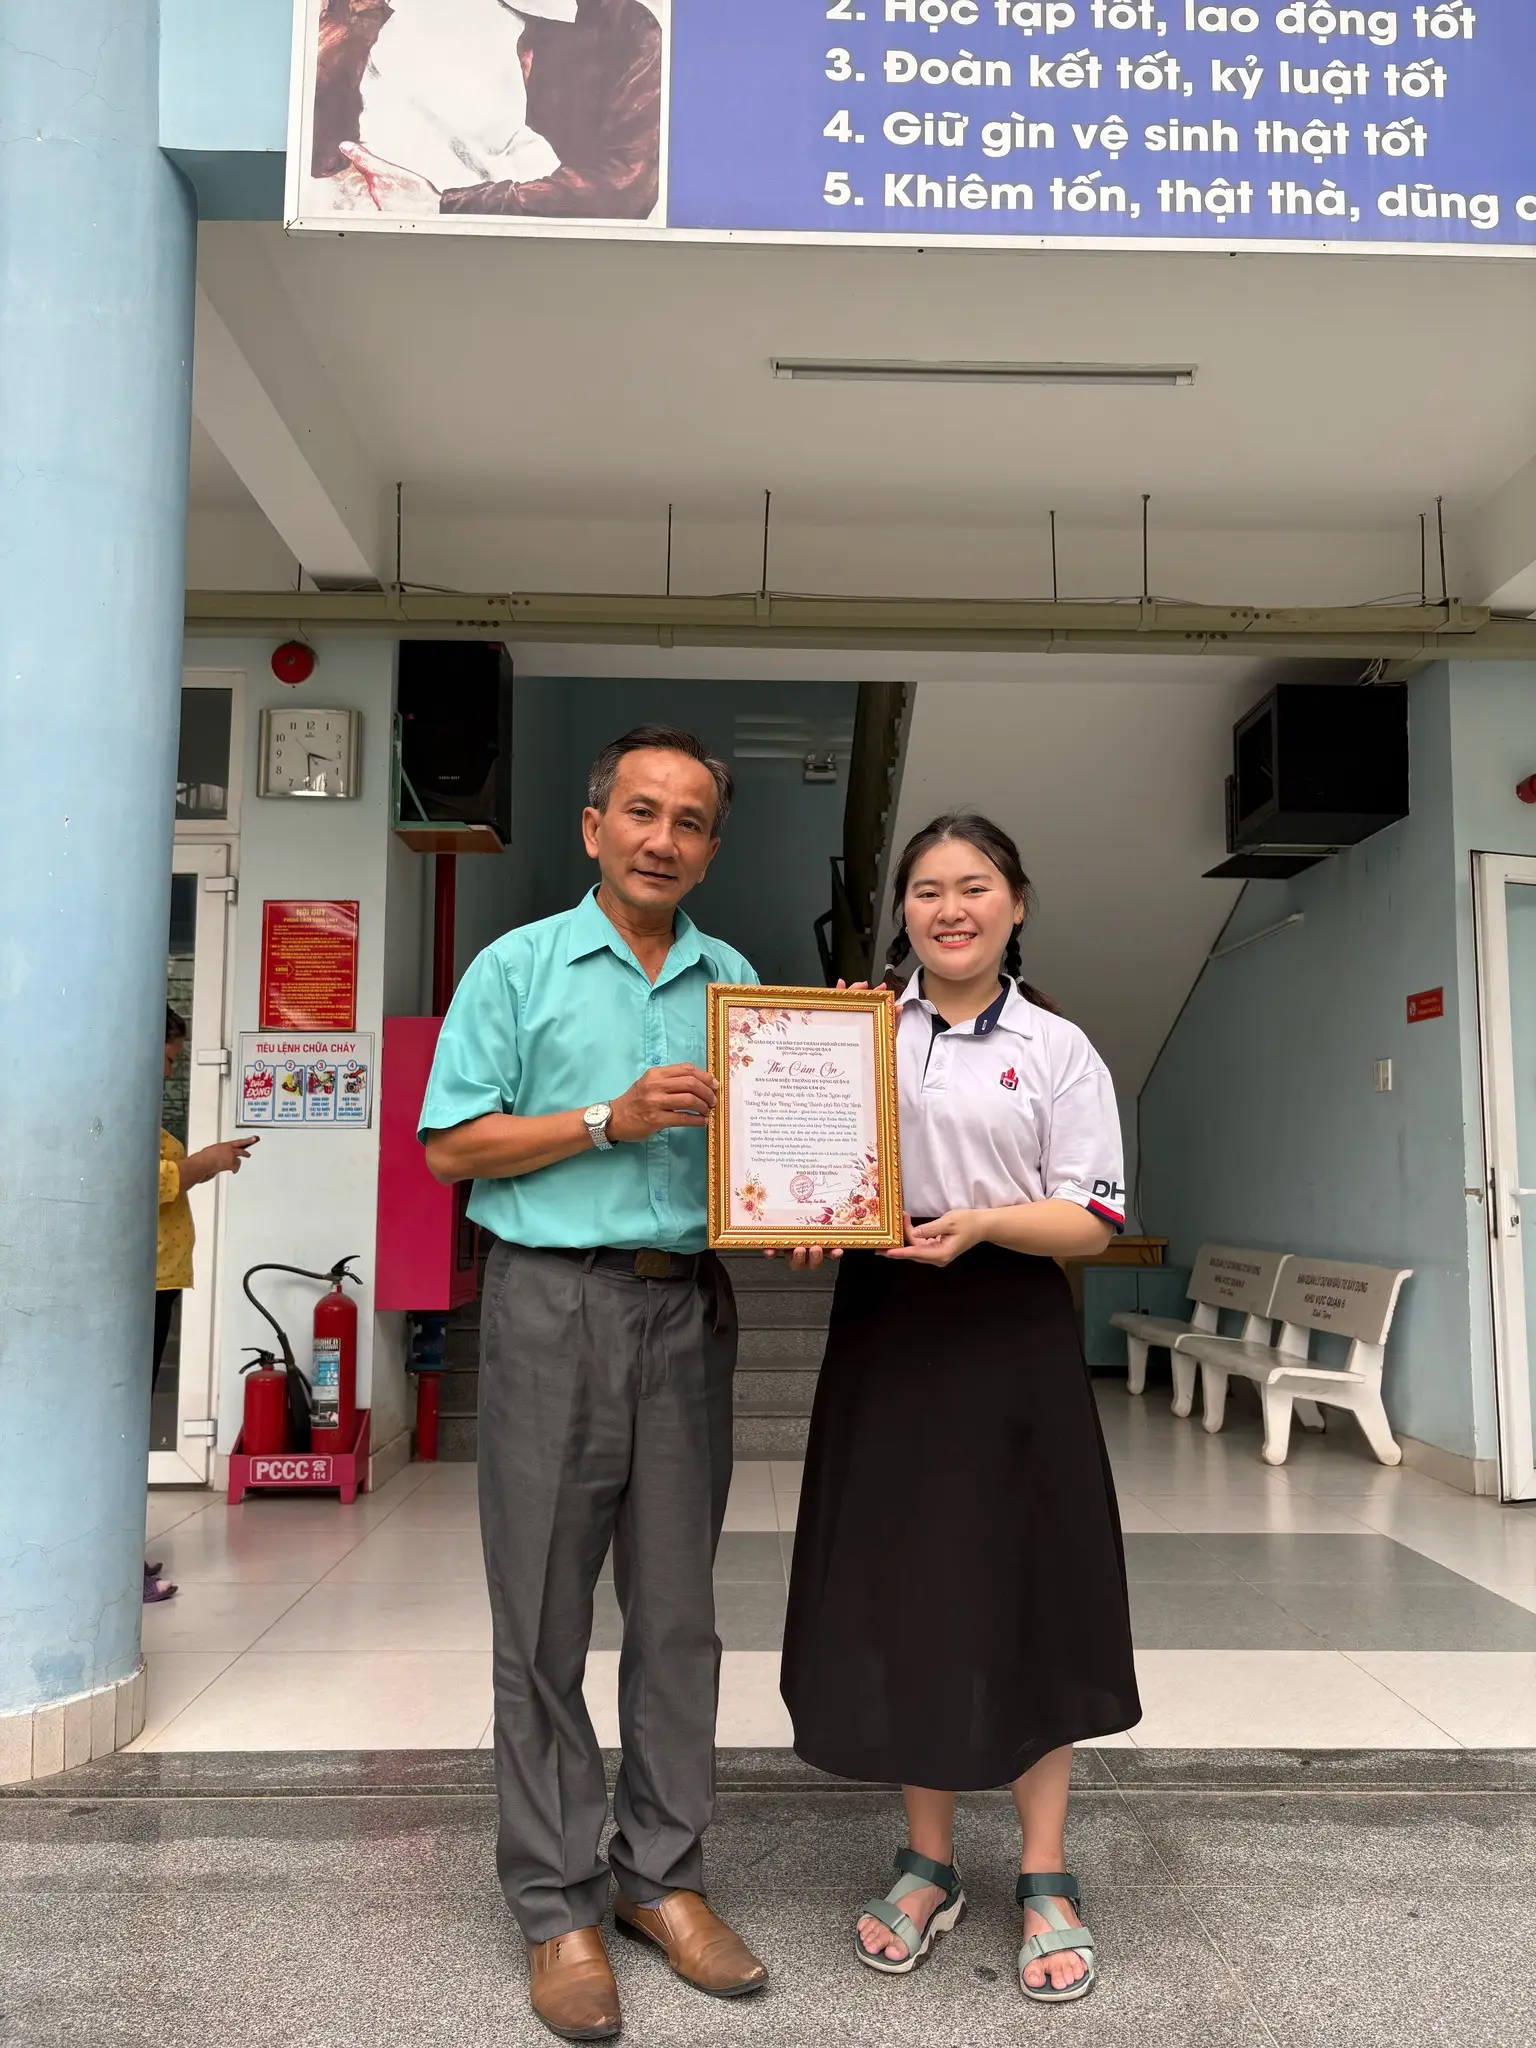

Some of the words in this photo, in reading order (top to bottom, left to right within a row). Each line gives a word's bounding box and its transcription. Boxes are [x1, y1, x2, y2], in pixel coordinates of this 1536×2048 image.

[825, 0, 866, 21] 2.
[885, 0, 979, 34] Học
[1185, 0, 1260, 33] lao
[1275, 0, 1397, 46] động
[1412, 0, 1476, 39] tốt
[824, 47, 866, 82] 3.
[883, 48, 1011, 87] Đoàn
[1029, 47, 1103, 89] kết
[1116, 49, 1193, 97] tốt,
[1211, 54, 1264, 100] kỷ
[1279, 59, 1370, 104] luật
[1383, 57, 1448, 98] tốt
[823, 109, 865, 144] 4.
[882, 111, 969, 147] Giữ
[981, 111, 1055, 158] gìn
[1071, 114, 1129, 160] vệ
[1144, 118, 1239, 152] sinh
[1254, 118, 1350, 164] thật
[1363, 116, 1428, 157] tốt
[822, 171, 864, 206] 5.
[884, 173, 1034, 210] Khiêm
[1049, 169, 1140, 219] tốn,
[1156, 177, 1254, 224] thật
[1267, 178, 1360, 223] thà,
[1377, 183, 1499, 230] dũng
[290, 722, 297, 731] 11
[307, 721, 316, 731] 12
[326, 722, 330, 732] 1
[275, 733, 286, 743] 10
[335, 735, 342, 744] 2
[276, 750, 282, 759] 9
[336, 751, 342, 760] 3
[275, 766, 282, 775] 8
[289, 778, 295, 788] 7
[256, 1042, 274, 1053] TIÊU
[277, 1042, 300, 1056] LỆNH
[302, 1042, 329, 1054] CHỮA
[330, 1042, 356, 1054] CHÁY
[256, 1461, 309, 1480] PCCC
[312, 1472, 326, 1480] 114
